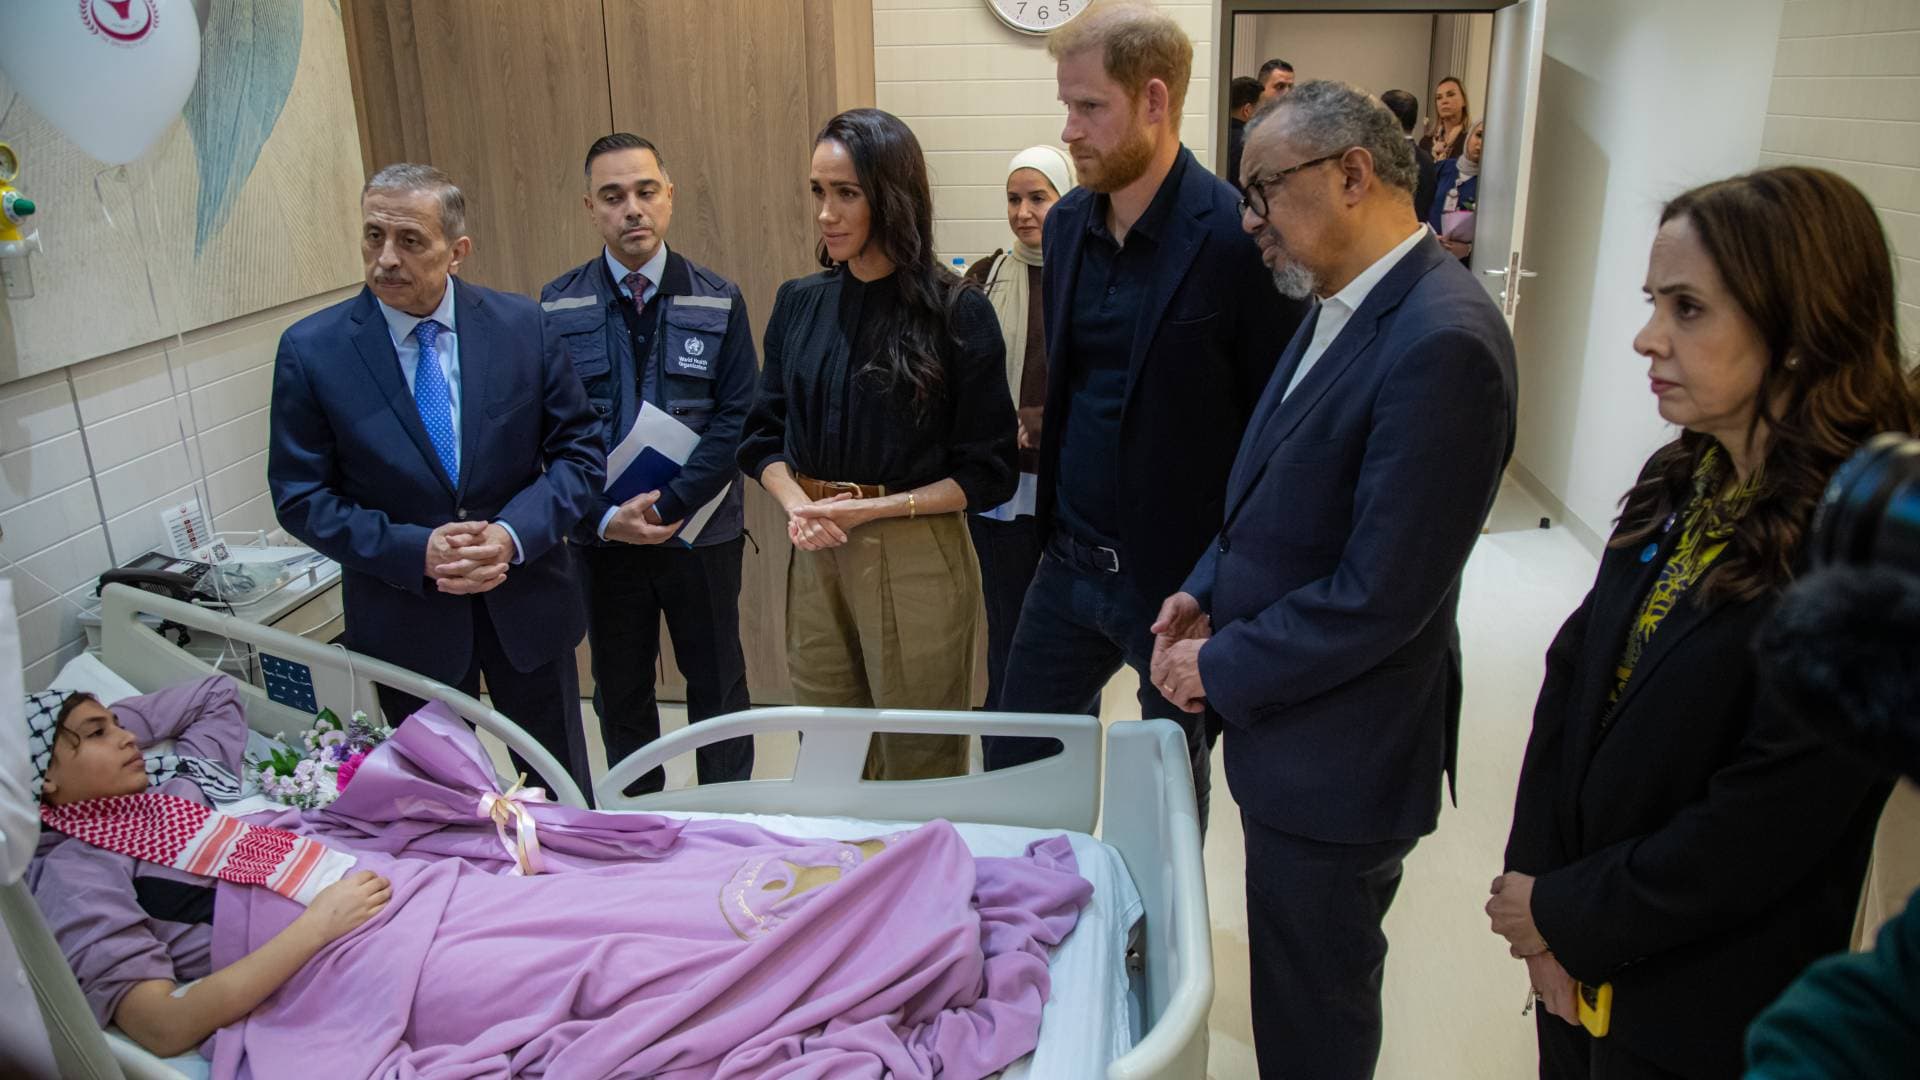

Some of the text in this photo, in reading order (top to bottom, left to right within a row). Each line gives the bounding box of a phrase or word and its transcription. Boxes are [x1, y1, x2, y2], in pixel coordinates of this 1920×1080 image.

[1016, 2, 1028, 15] 7
[1058, 0, 1070, 12] 5
[1038, 5, 1049, 20] 6
[678, 355, 708, 366] World Health
